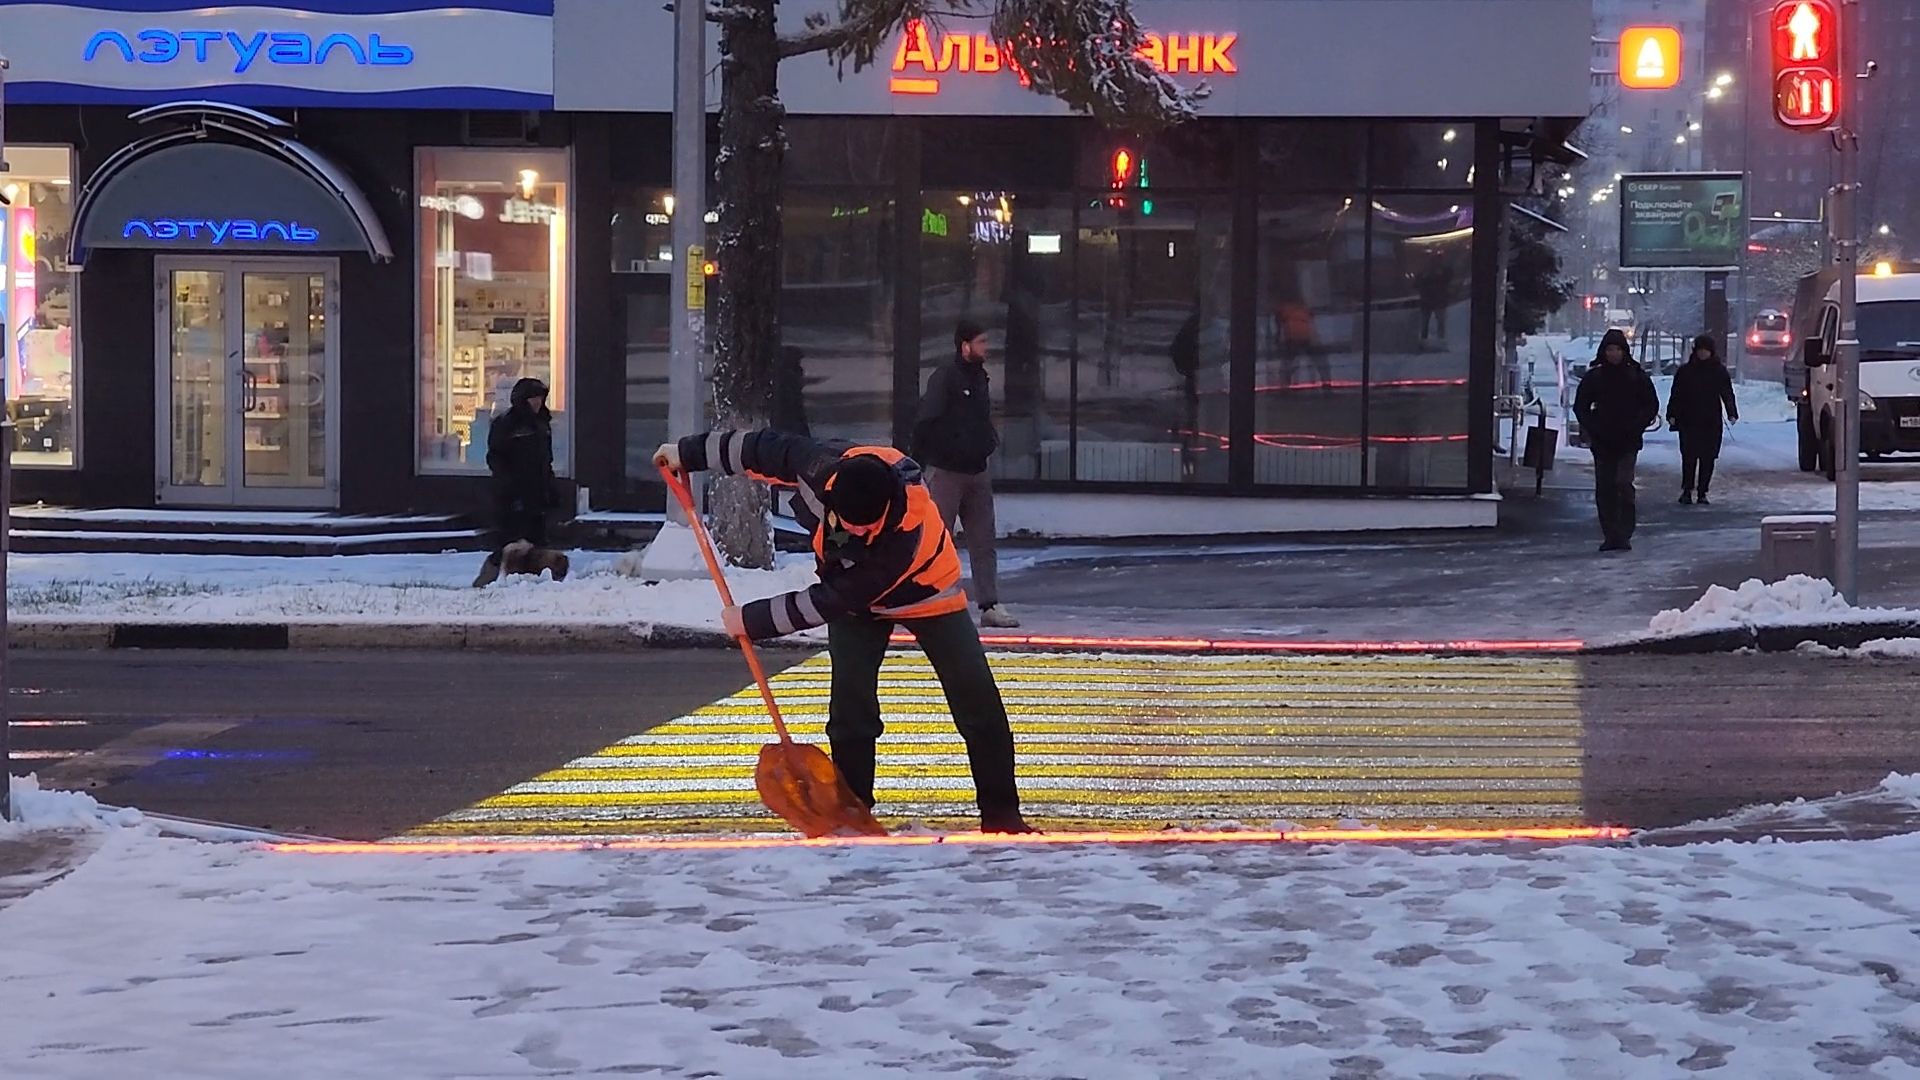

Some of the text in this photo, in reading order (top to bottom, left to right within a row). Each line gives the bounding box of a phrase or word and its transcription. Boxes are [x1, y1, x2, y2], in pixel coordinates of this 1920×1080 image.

[891, 19, 1237, 94] Аль анк
[1630, 200, 1693, 210] Подключайте
